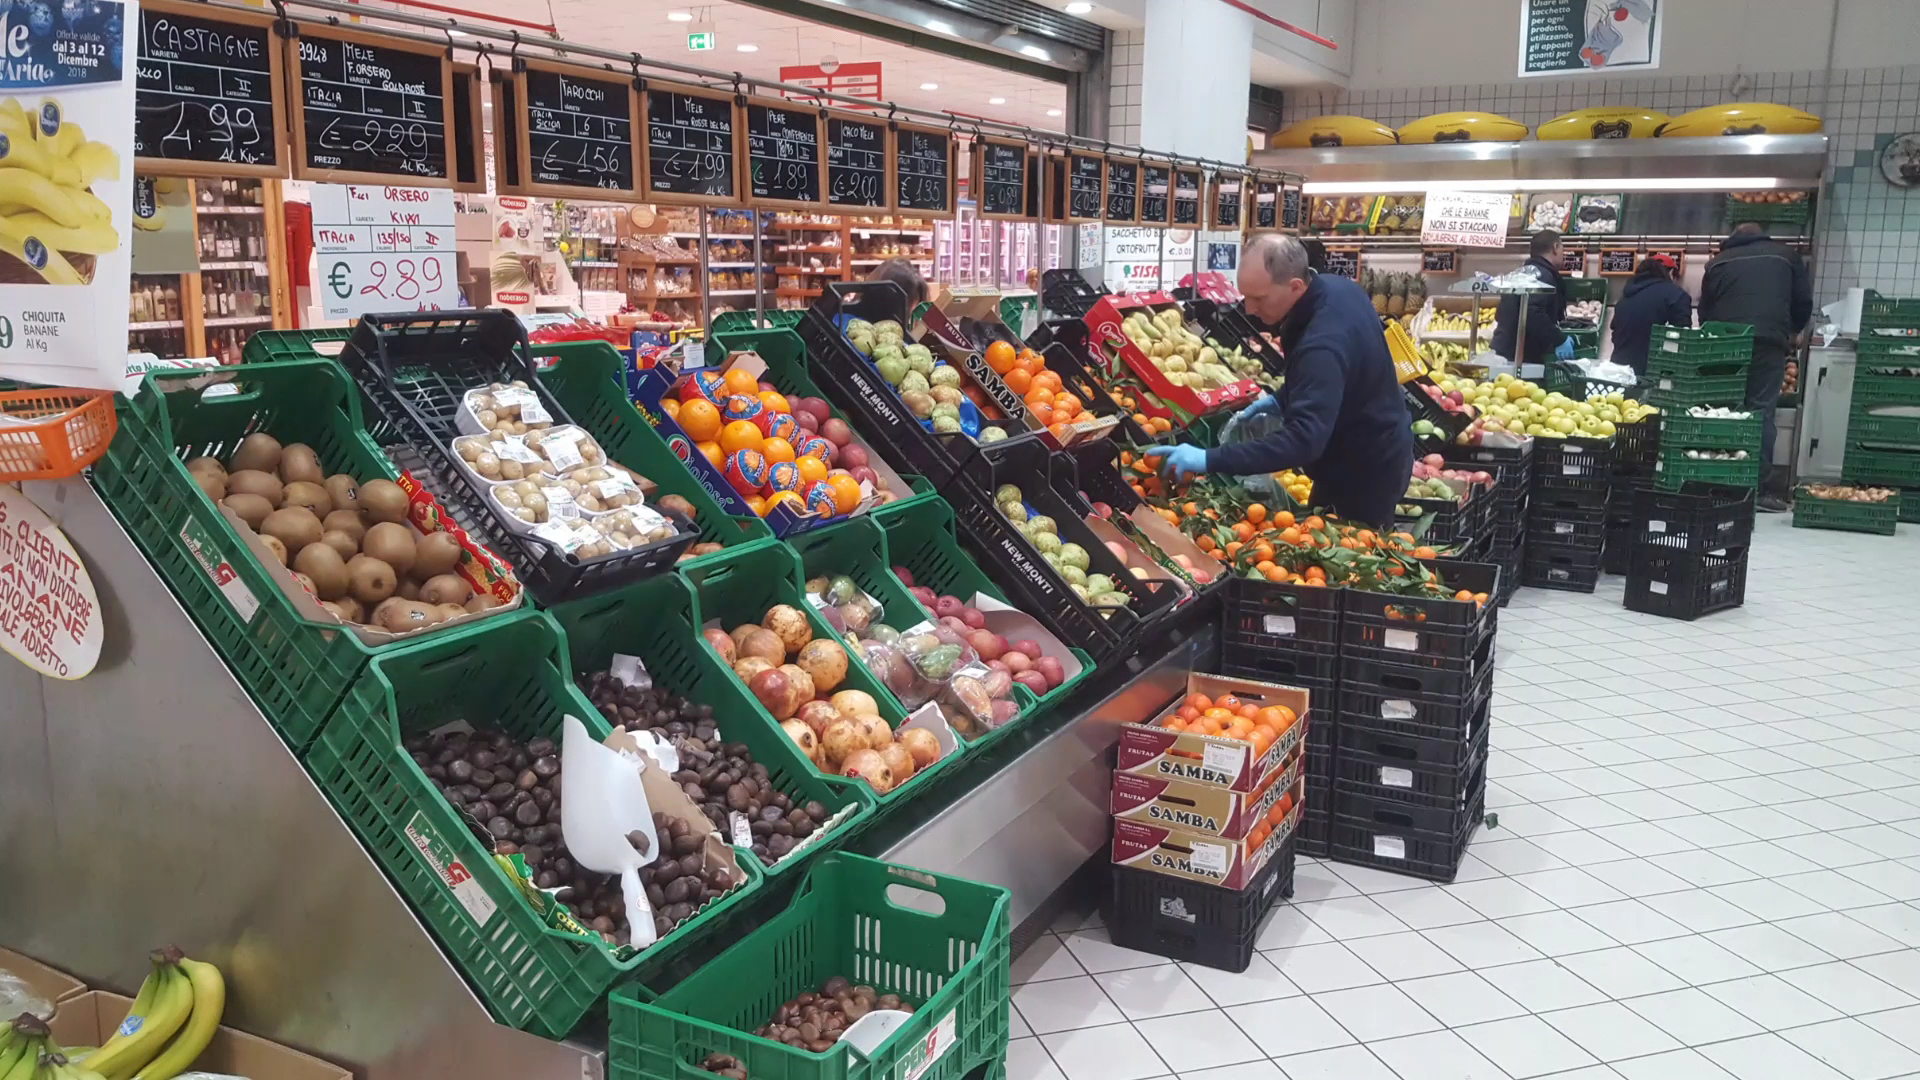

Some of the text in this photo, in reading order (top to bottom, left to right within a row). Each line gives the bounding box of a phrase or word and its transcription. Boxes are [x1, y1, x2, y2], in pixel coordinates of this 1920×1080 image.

[1532, 6, 1571, 16] sacchetto
[1531, 16, 1565, 27] per ogni
[56, 29, 101, 41] Offerte valide
[152, 19, 260, 58] CASTAGNE
[1530, 33, 1574, 42] utilizzando
[52, 40, 105, 56] dal 3 al 12
[344, 43, 375, 62] MELE
[1529, 41, 1573, 53] gli appositi
[58, 53, 98, 67] Dicembre
[151, 49, 179, 60] VARIETA'
[1529, 51, 1571, 62] guanti per
[1528, 59, 1566, 69] sceglierlo
[67, 66, 87, 78] 2018
[307, 86, 342, 103] ITALIA
[683, 96, 704, 114] MELE
[531, 109, 591, 131] ITALIA 6
[768, 109, 786, 125] PERE
[162, 100, 261, 151] 4.99
[651, 126, 672, 140] ITALIA
[313, 154, 342, 166] PREZZO
[687, 153, 725, 181] 1.99
[539, 172, 560, 181] PREZZO
[773, 161, 808, 190] 1.89
[384, 185, 430, 202] ORSERO
[1441, 207, 1489, 219] CHE LE BANANE
[1112, 228, 1152, 238] SACCHETTO
[1429, 220, 1498, 232] NON SI STACCANO
[318, 230, 356, 243] ITALIA
[327, 256, 443, 301] € 2.89
[1131, 265, 1161, 278] SISA
[499, 292, 528, 302] noberasco
[22, 310, 66, 324] CHIQUITA
[23, 323, 60, 337] BANANE
[944, 322, 966, 347] FRUTAS
[36, 339, 48, 353] Kg
[965, 353, 1026, 420] SAMBA
[850, 372, 900, 426] NEW MONTI
[398, 475, 414, 493] TTA
[18, 519, 80, 585] CLIENTI
[1000, 538, 1054, 595] NEW MONTI
[14, 539, 93, 626] DI NON DIVIDERE
[0, 578, 58, 645] IVOLGERSI
[20, 629, 69, 677] ADDETTO
[1127, 748, 1155, 757] FRUTAS
[1159, 760, 1229, 785] SAMBA
[1119, 792, 1146, 802] FRUTAS
[1149, 805, 1218, 831] SAMBA
[1121, 840, 1148, 850] FRUTAS
